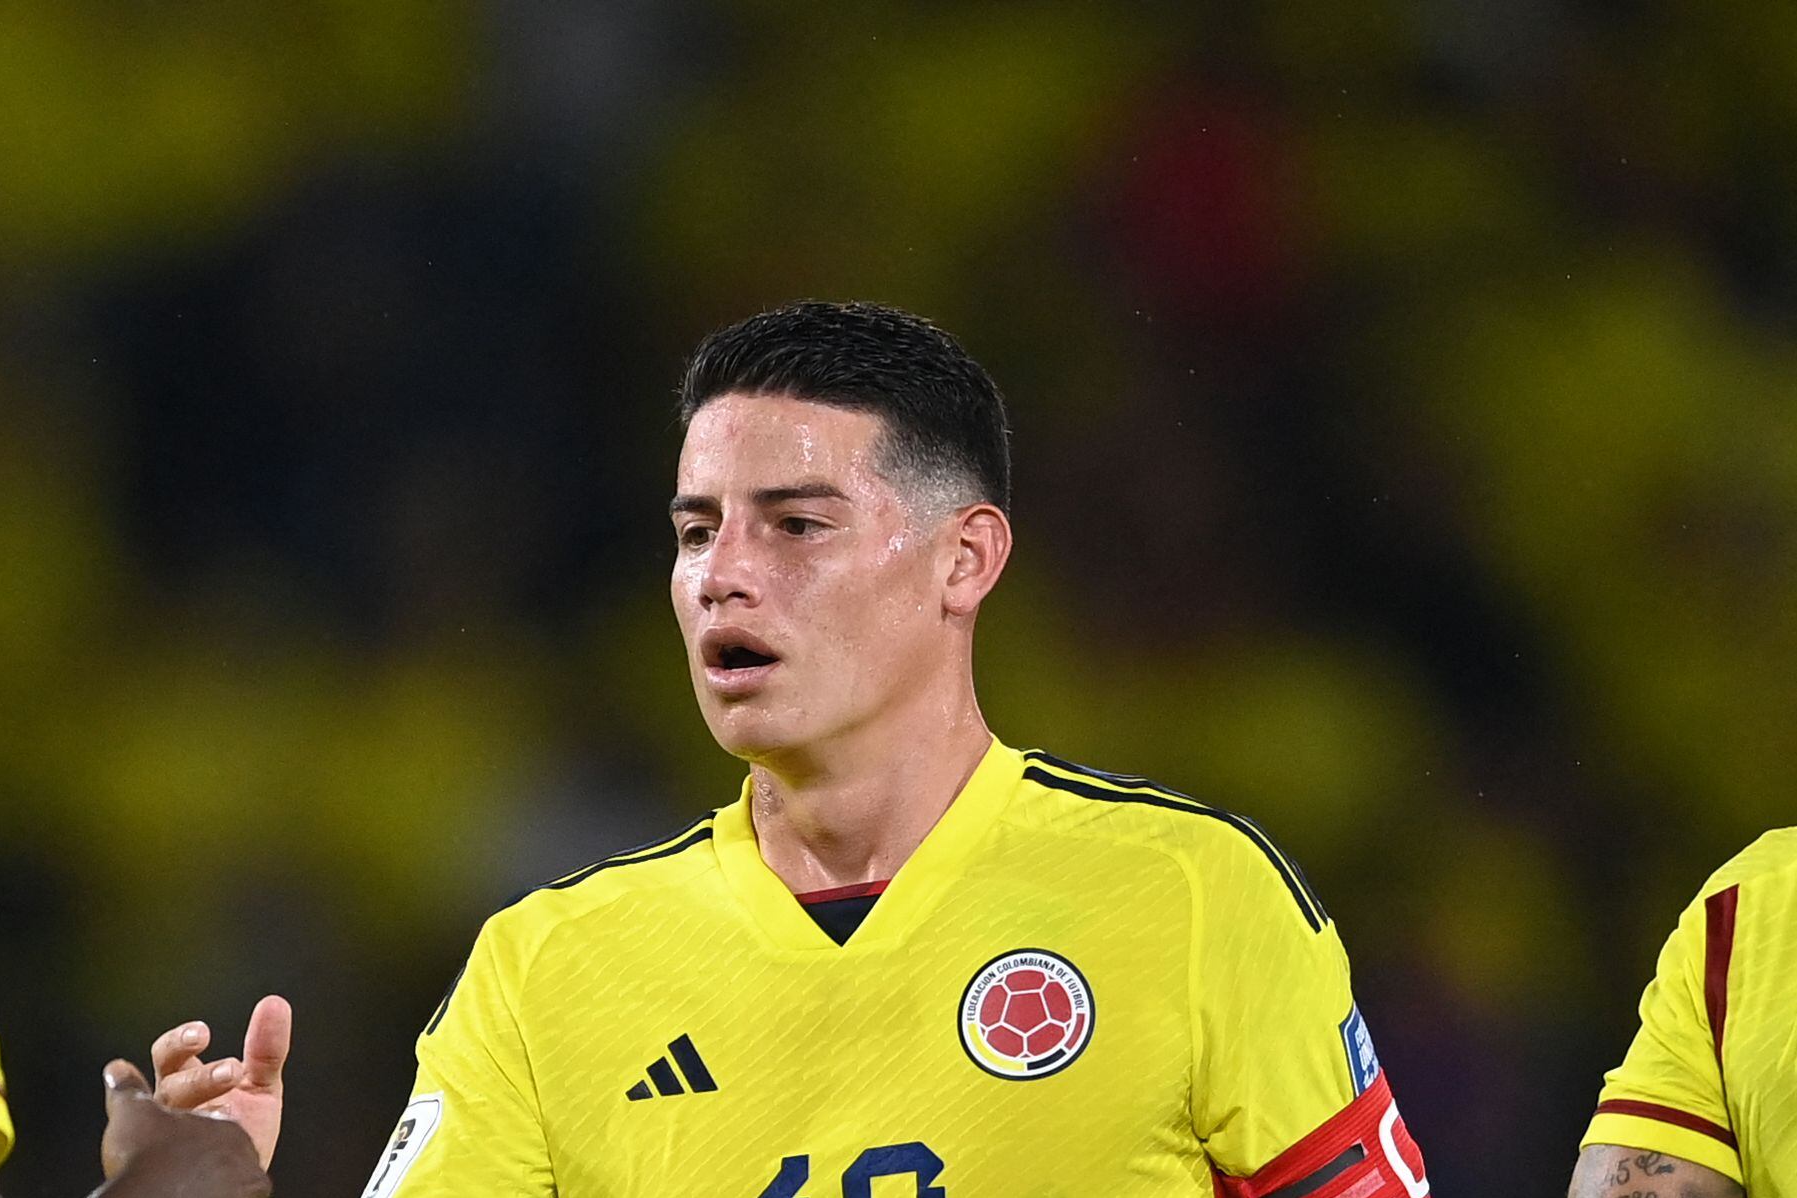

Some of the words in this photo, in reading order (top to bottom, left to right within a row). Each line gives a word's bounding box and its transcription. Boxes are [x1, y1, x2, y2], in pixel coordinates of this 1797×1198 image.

[967, 971, 996, 1021] FEDERACION
[997, 958, 1056, 974] COLOMBIANA
[1056, 967, 1067, 979] DE
